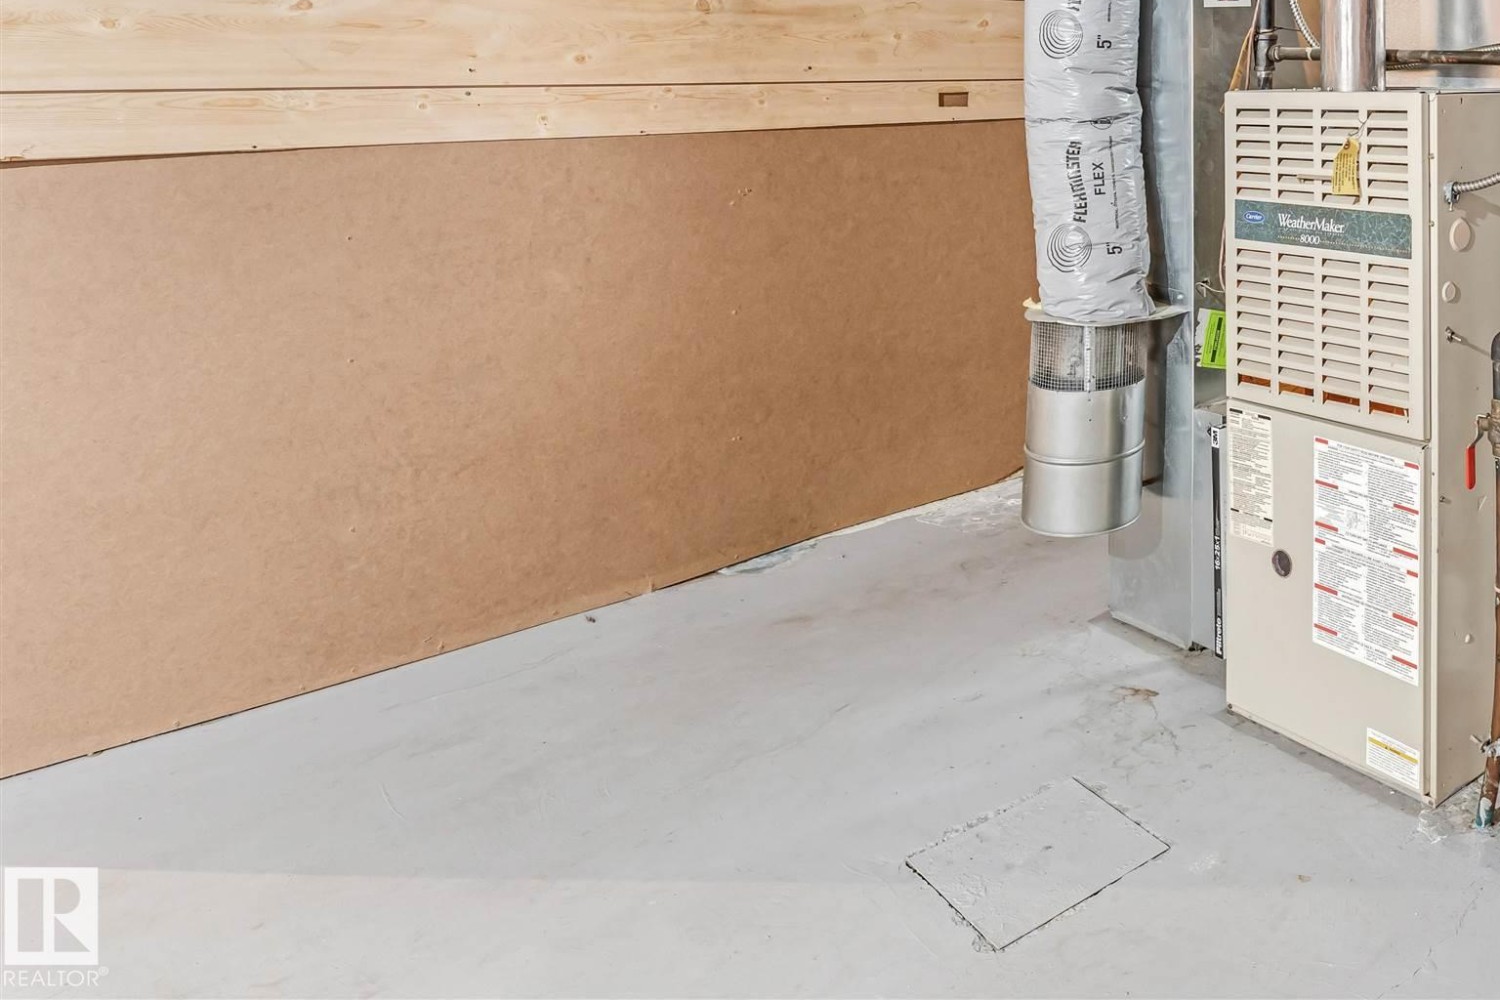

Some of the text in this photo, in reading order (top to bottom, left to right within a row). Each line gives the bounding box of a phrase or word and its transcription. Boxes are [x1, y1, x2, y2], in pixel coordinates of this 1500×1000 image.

[1097, 34, 1112, 49] 5"
[1092, 162, 1106, 195] FLEX
[1278, 213, 1345, 233] WeatherMaker
[1300, 234, 1320, 245] 8000
[1107, 242, 1123, 255] 5"
